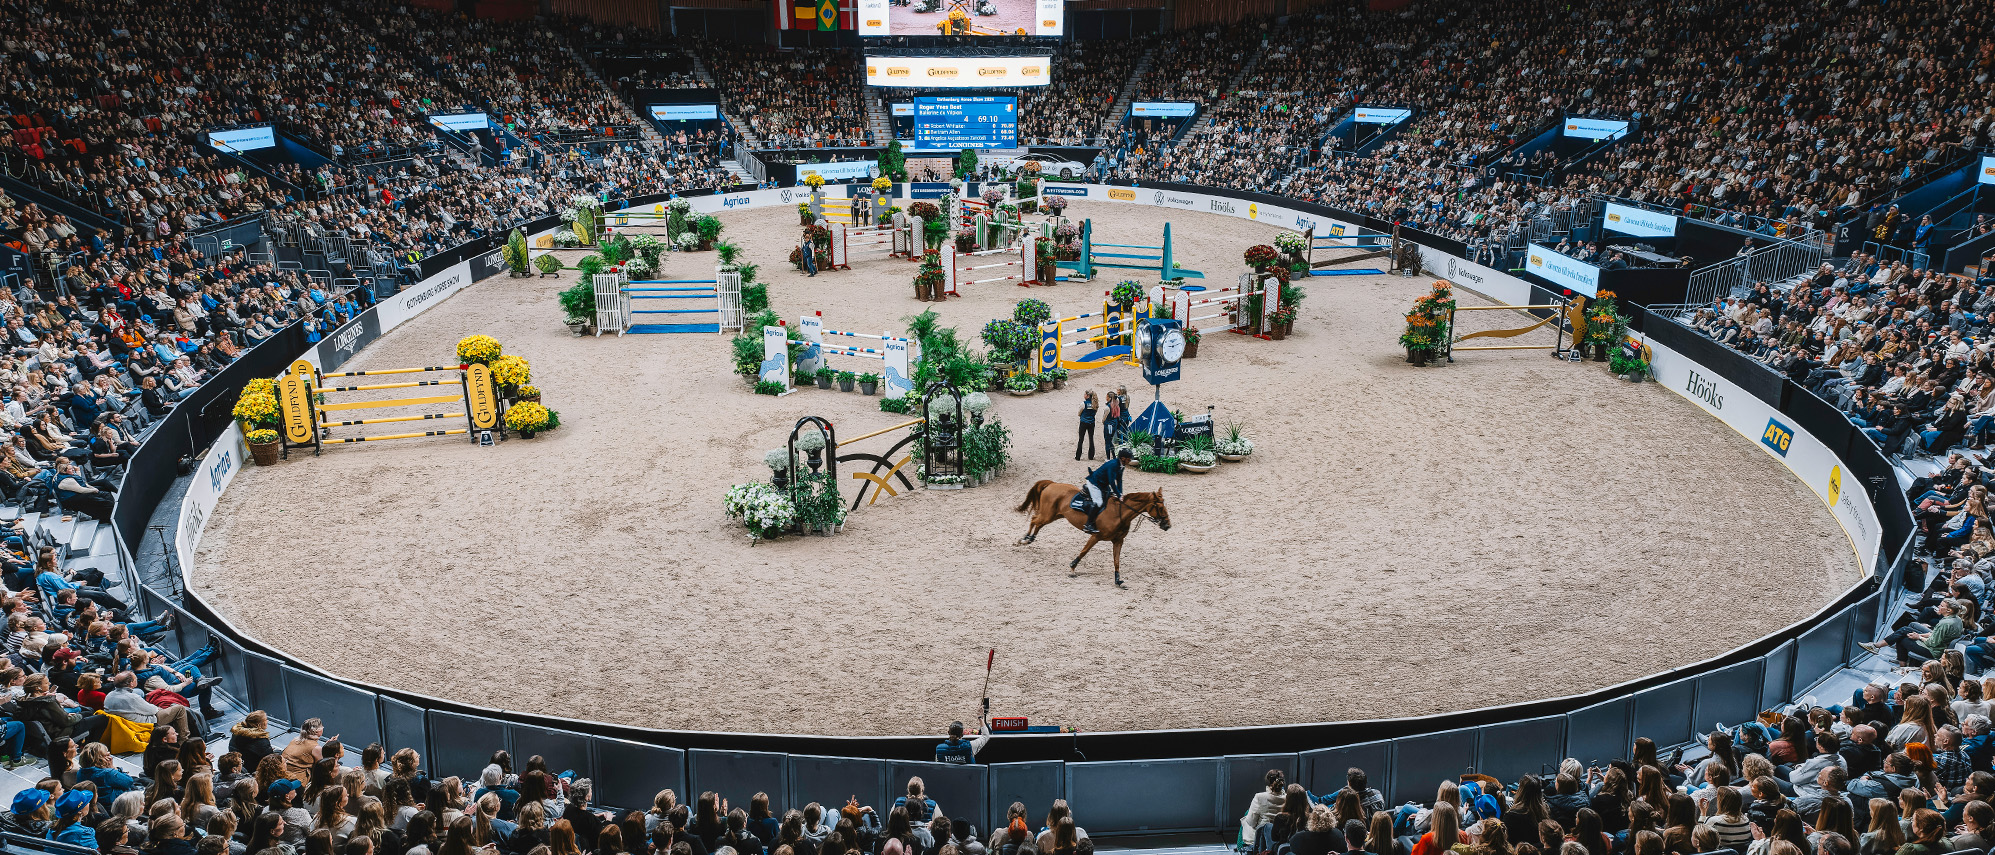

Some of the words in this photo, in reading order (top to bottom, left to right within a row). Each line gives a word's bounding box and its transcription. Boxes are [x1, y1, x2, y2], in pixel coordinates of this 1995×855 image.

[1210, 199, 1236, 214] Hööks
[1330, 226, 1343, 237] ATG
[1840, 227, 1849, 238] R
[12, 254, 22, 267] F
[1458, 267, 1484, 283] Volkswagen
[406, 287, 434, 310] GOTHENBURG
[447, 273, 460, 288] SHOW
[333, 321, 364, 352] LONGINES
[474, 368, 492, 424] GULDFYND
[1685, 369, 1724, 411] Hööks
[288, 380, 307, 438] GULDFYND
[1763, 423, 1790, 451] ATG
[209, 453, 228, 493] Agria
[996, 720, 1024, 728] FINISH
